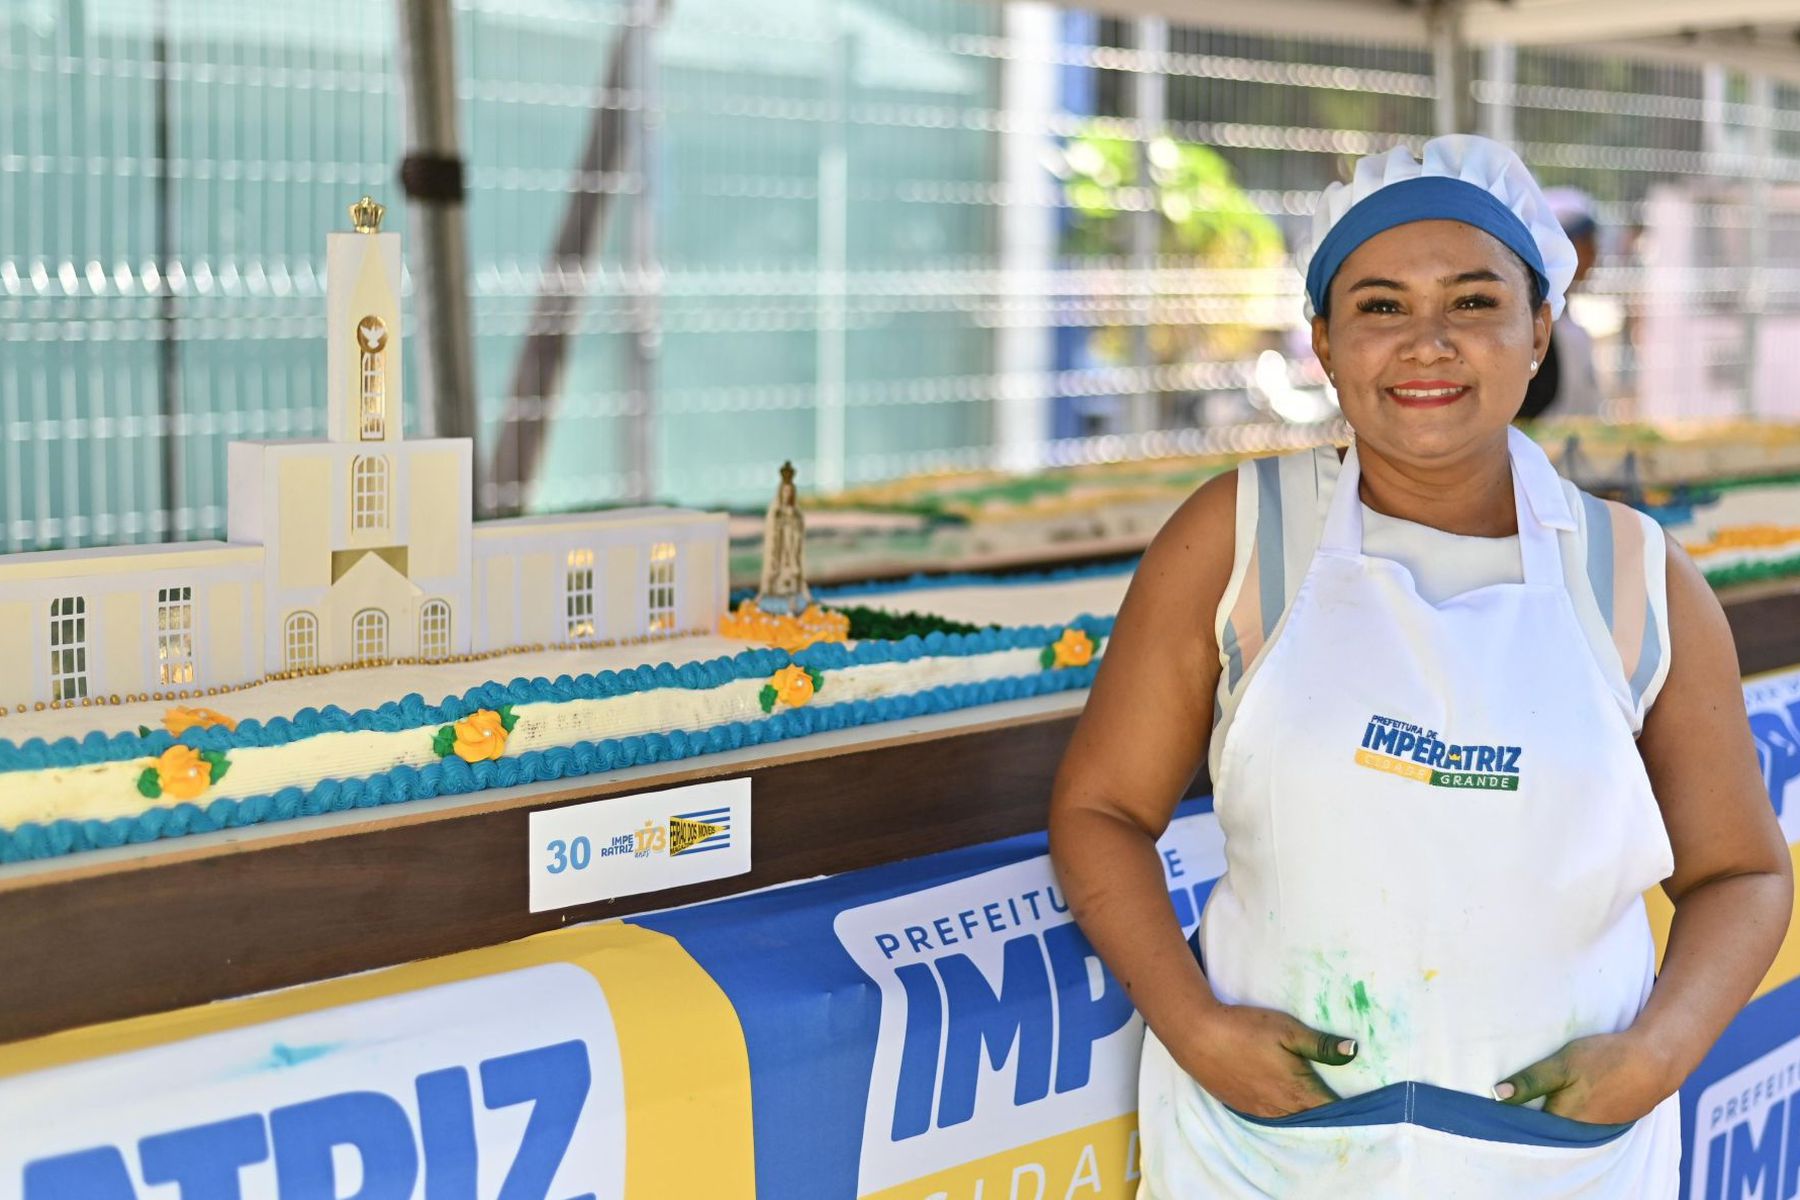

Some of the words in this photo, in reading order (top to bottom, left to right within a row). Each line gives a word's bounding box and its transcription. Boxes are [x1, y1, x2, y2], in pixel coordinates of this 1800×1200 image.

[1371, 714, 1423, 736] PREFEITURA
[1426, 729, 1438, 740] DE
[1361, 722, 1522, 774] IMPERATRIZ
[1440, 775, 1510, 788] GRANDE
[601, 844, 634, 857] RATRIZ
[611, 834, 634, 847] IMPE
[634, 826, 666, 853] 173
[546, 835, 591, 875] 30
[1711, 1060, 1800, 1130] PREFEIT
